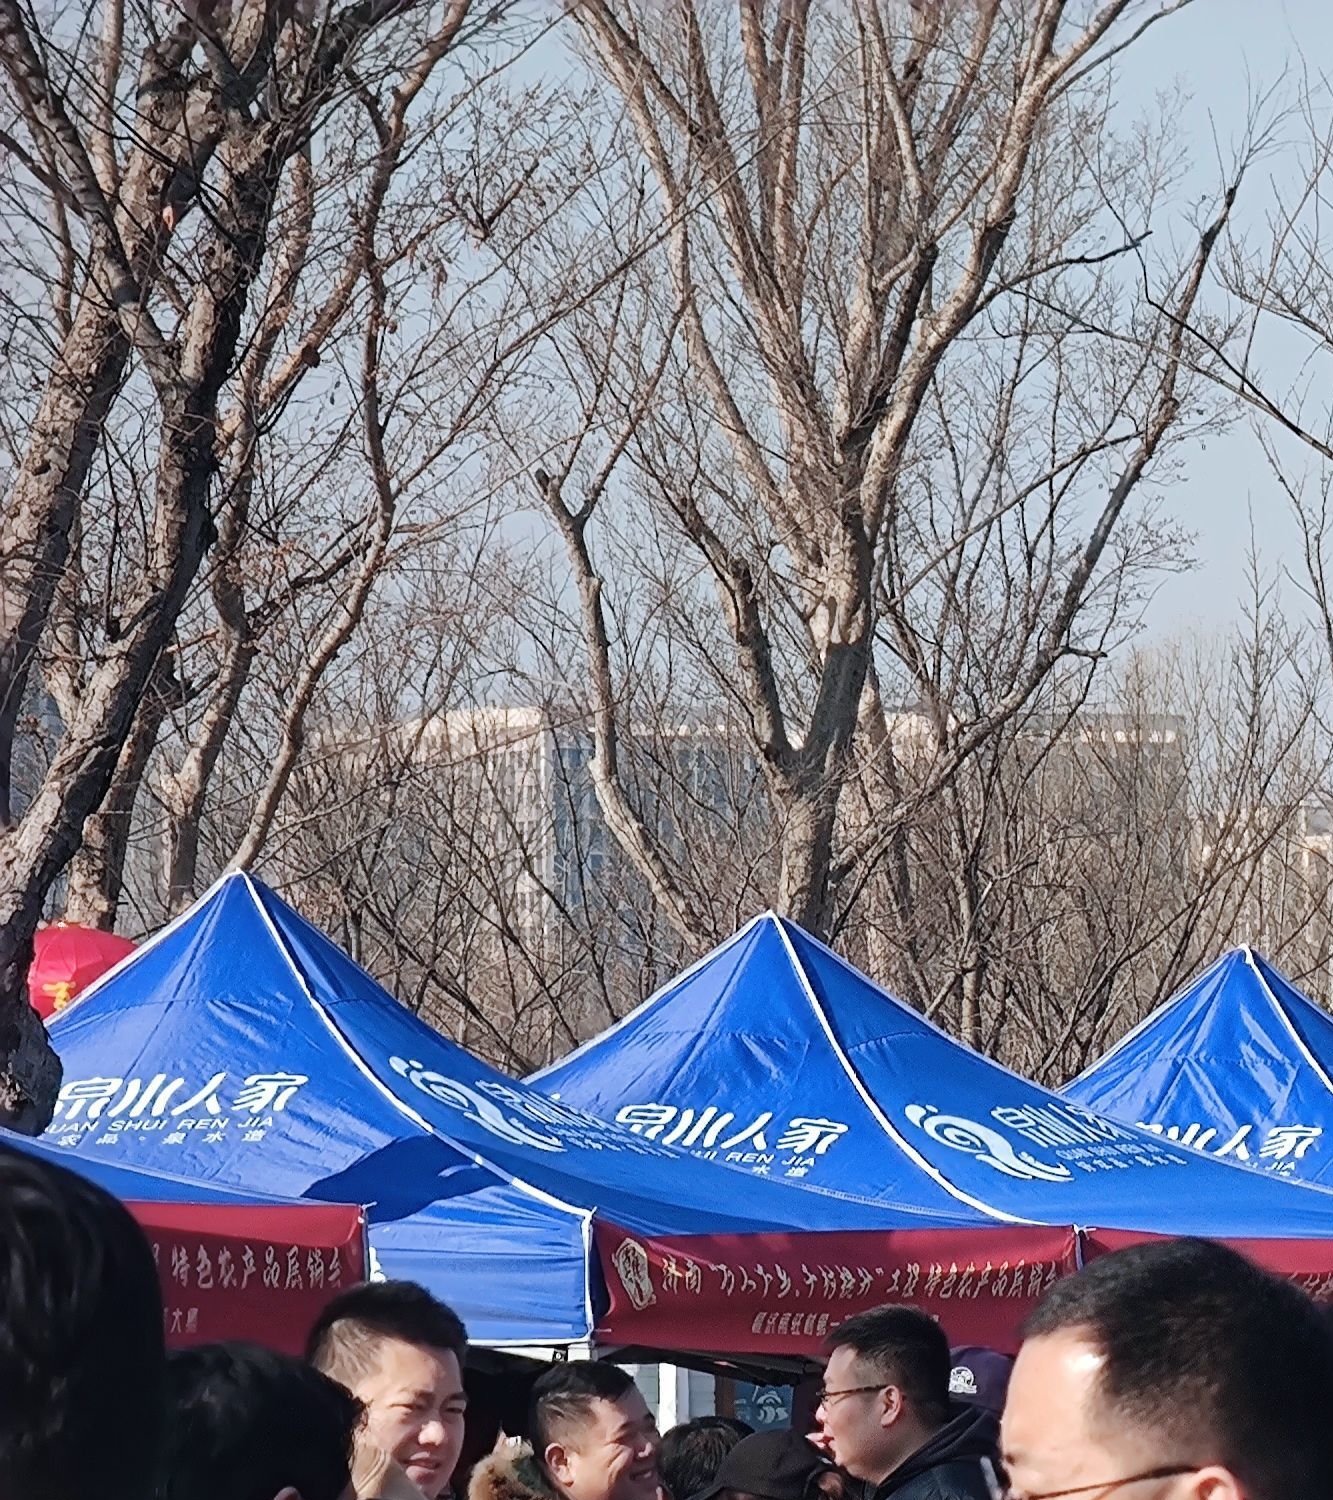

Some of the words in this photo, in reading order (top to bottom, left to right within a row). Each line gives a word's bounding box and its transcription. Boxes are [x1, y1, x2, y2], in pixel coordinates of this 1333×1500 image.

[107, 1119, 167, 1132] SHUI
[177, 1117, 229, 1130] REN
[238, 1116, 274, 1128] JIA
[726, 1152, 775, 1165] REN
[781, 1156, 816, 1168] JIA
